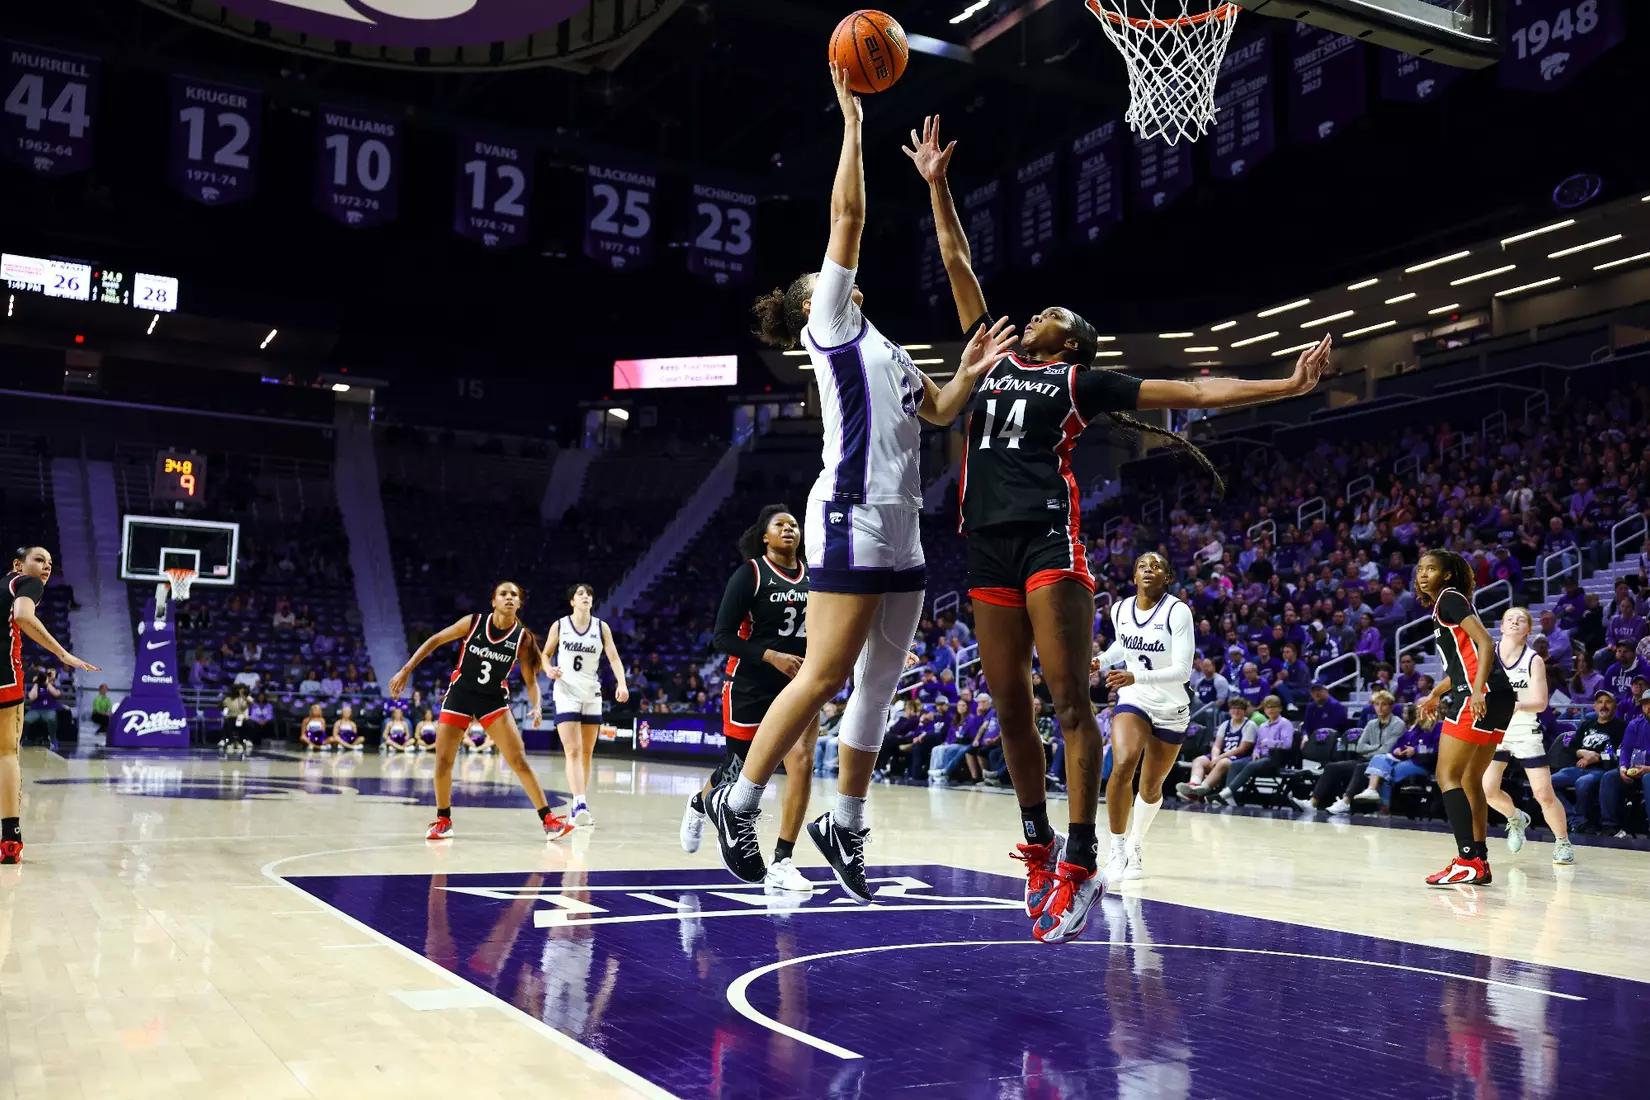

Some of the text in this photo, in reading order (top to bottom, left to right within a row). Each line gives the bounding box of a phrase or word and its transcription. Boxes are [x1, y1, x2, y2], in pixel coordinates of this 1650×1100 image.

[1511, 0, 1597, 60] 1948
[10, 51, 91, 78] MURRELL
[864, 36, 890, 80] ELITE
[4, 73, 90, 139] 44
[185, 85, 248, 109] KRUGER
[325, 111, 395, 137] WILLIAMS
[17, 137, 73, 157] 1962-64
[179, 106, 251, 169] 12
[325, 133, 392, 192] 10
[474, 140, 519, 162] EVANS
[186, 168, 238, 187] 1971-74
[464, 159, 526, 217] 12
[588, 164, 656, 188] BLACKMAN
[693, 184, 757, 206] RICHMOND
[590, 183, 652, 239] 25
[694, 202, 753, 256] 23
[54, 273, 80, 292] 26
[141, 286, 167, 303] 28
[979, 398, 1027, 450] 14
[180, 474, 195, 496] 9
[468, 643, 514, 664] CINCINNATI
[562, 640, 598, 655] Wildcats
[1120, 634, 1167, 652] Wildcats
[477, 661, 494, 685] 3
[572, 655, 584, 672] 6
[141, 674, 173, 684] Channel
